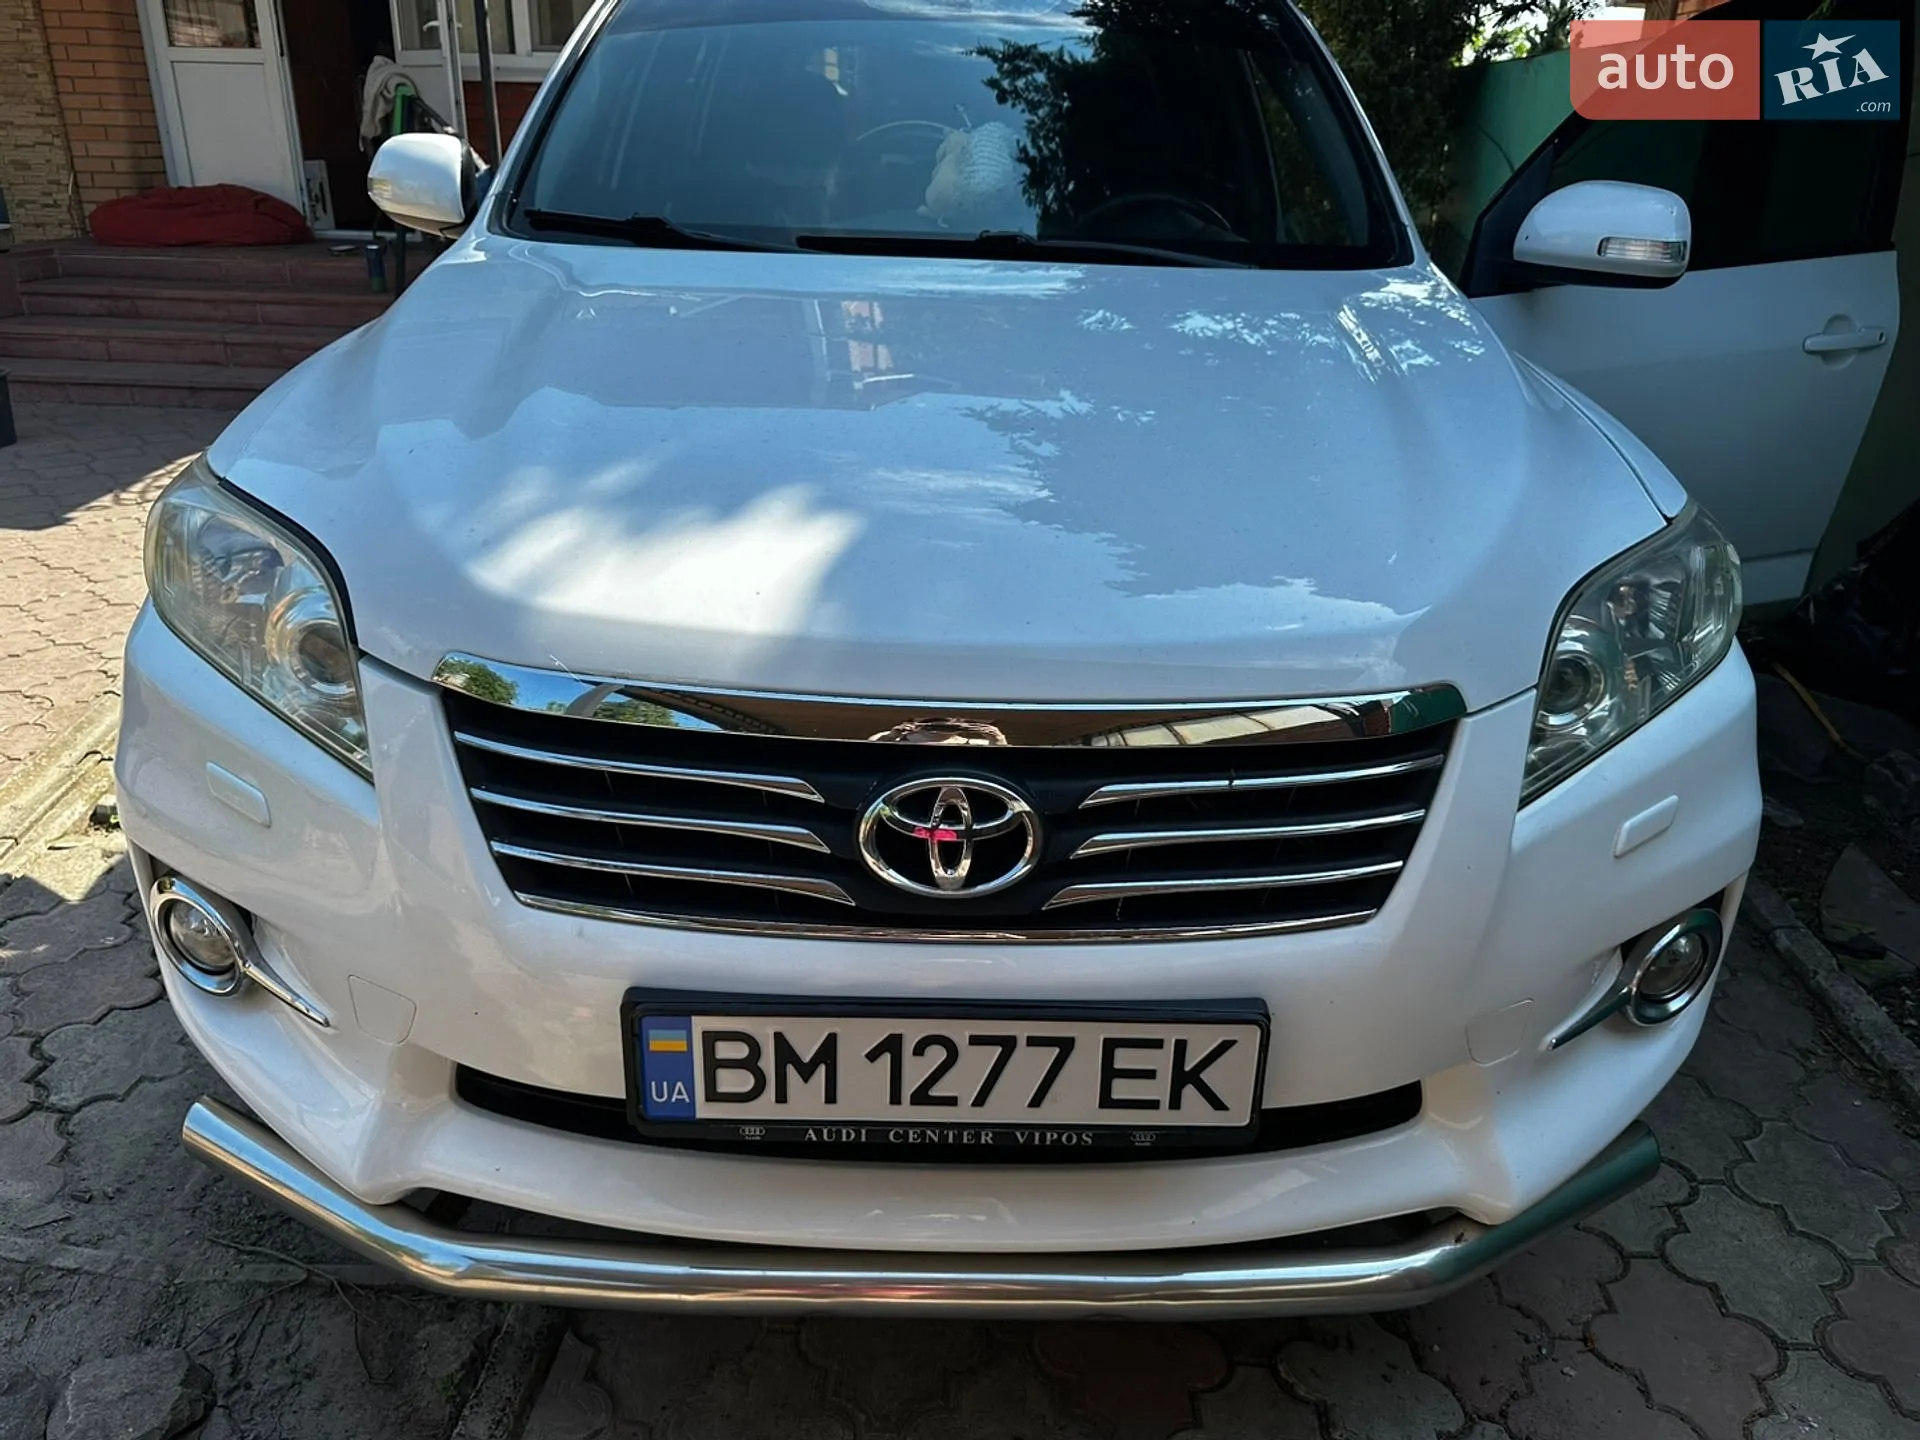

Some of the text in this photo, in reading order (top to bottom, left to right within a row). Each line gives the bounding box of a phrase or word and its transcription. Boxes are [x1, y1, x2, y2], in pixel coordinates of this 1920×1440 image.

[702, 1031, 1239, 1111] BM 1277 EK
[651, 1081, 691, 1104] UA
[804, 1127, 1094, 1146] AUDI CENTER VIPOS
